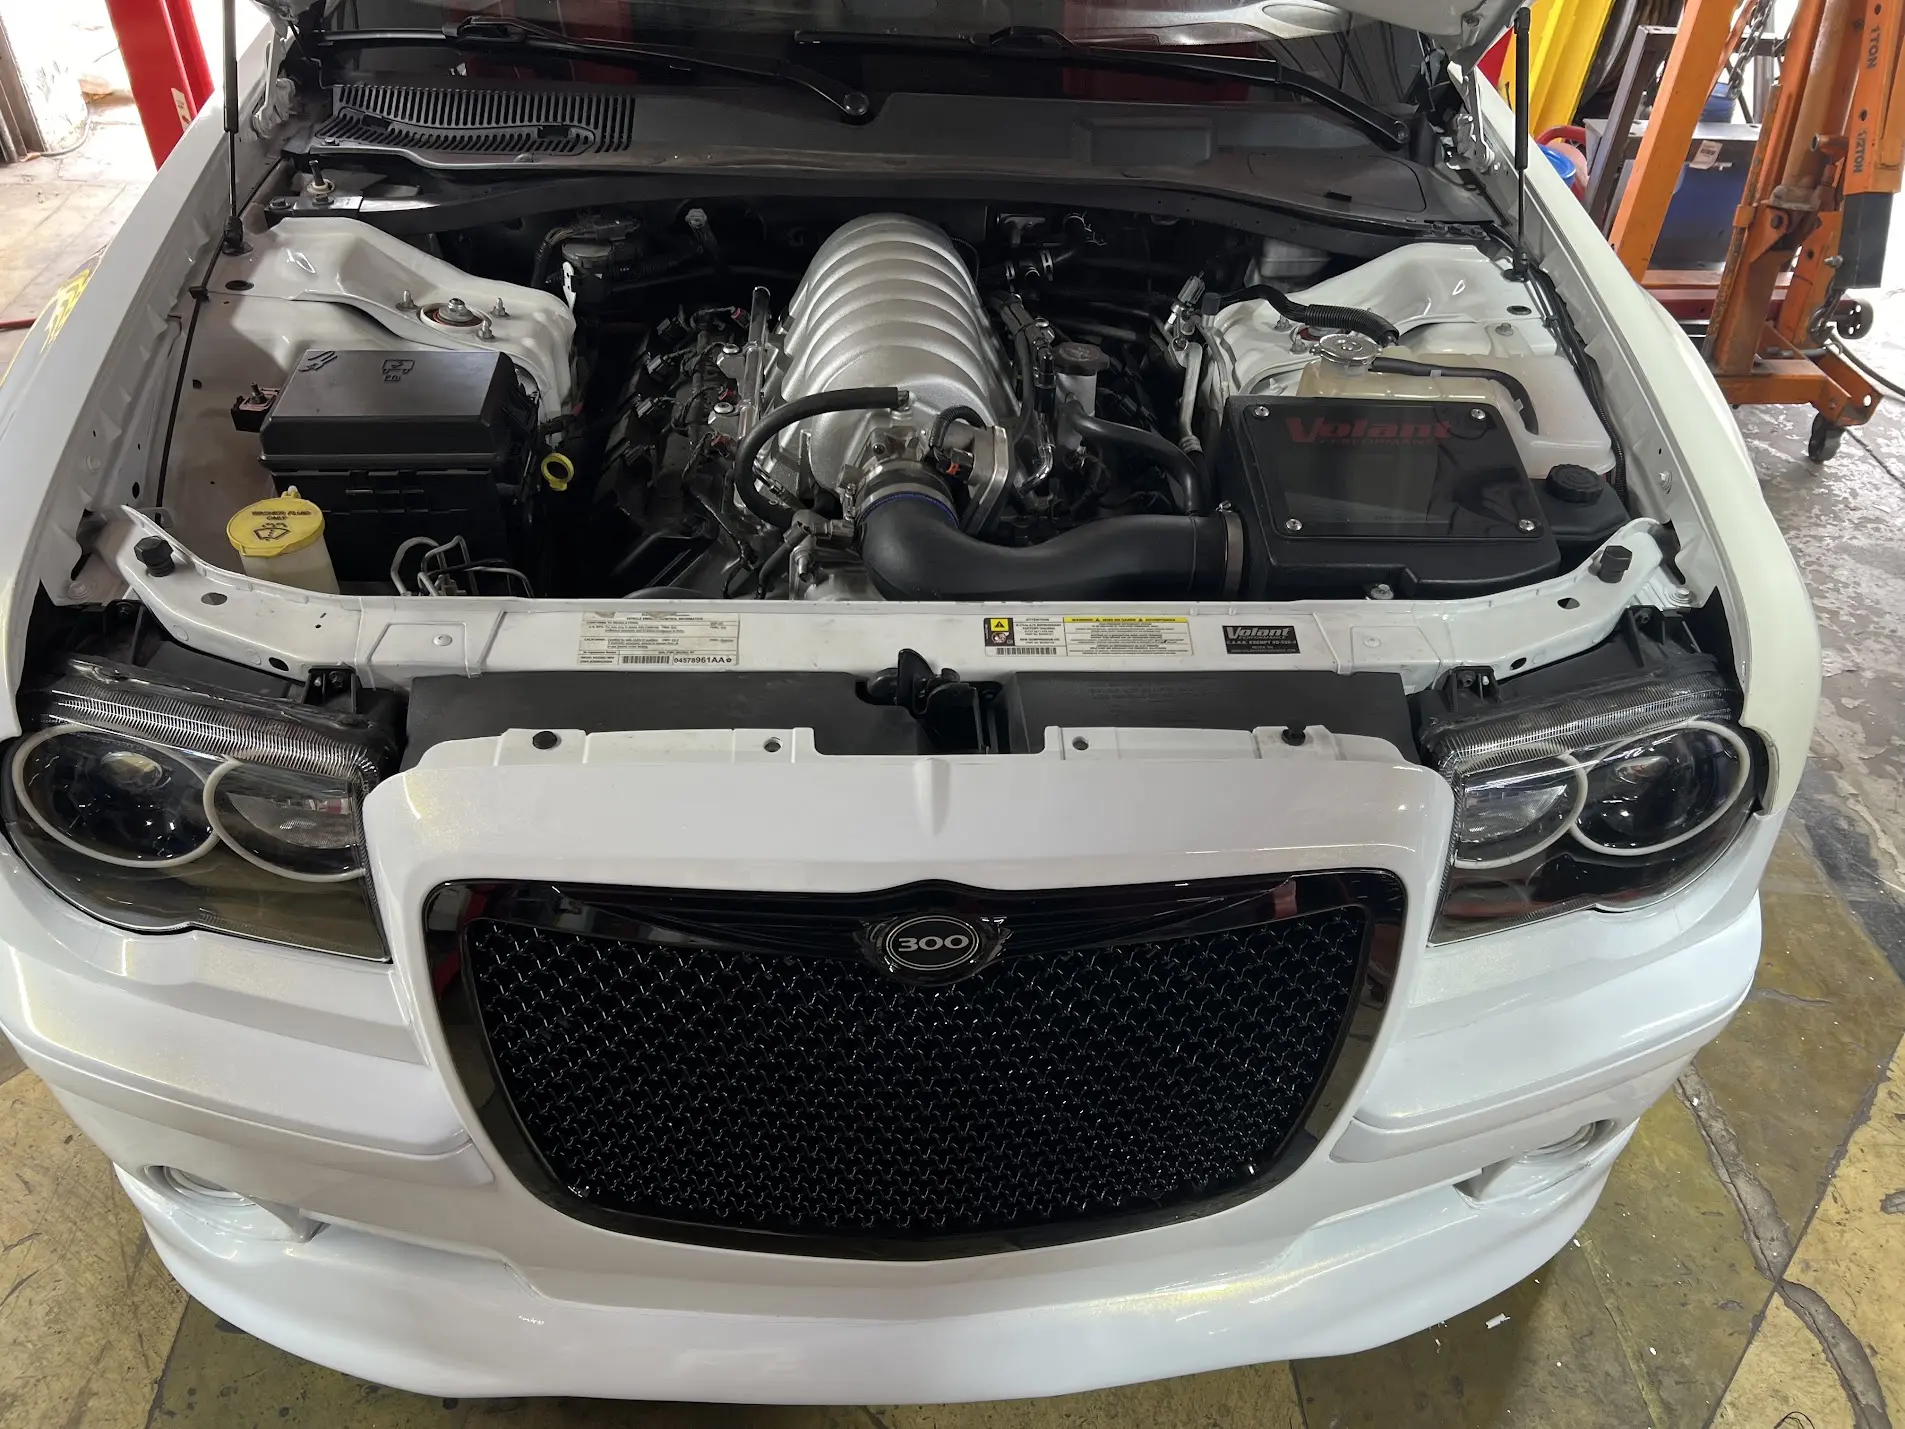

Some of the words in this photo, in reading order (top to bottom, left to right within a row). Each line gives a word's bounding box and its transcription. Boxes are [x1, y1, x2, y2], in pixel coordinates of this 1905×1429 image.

[1286, 417, 1452, 442] Volant
[1227, 627, 1289, 639] Volant
[673, 656, 725, 664] 04578961AA
[898, 934, 969, 952] 300
